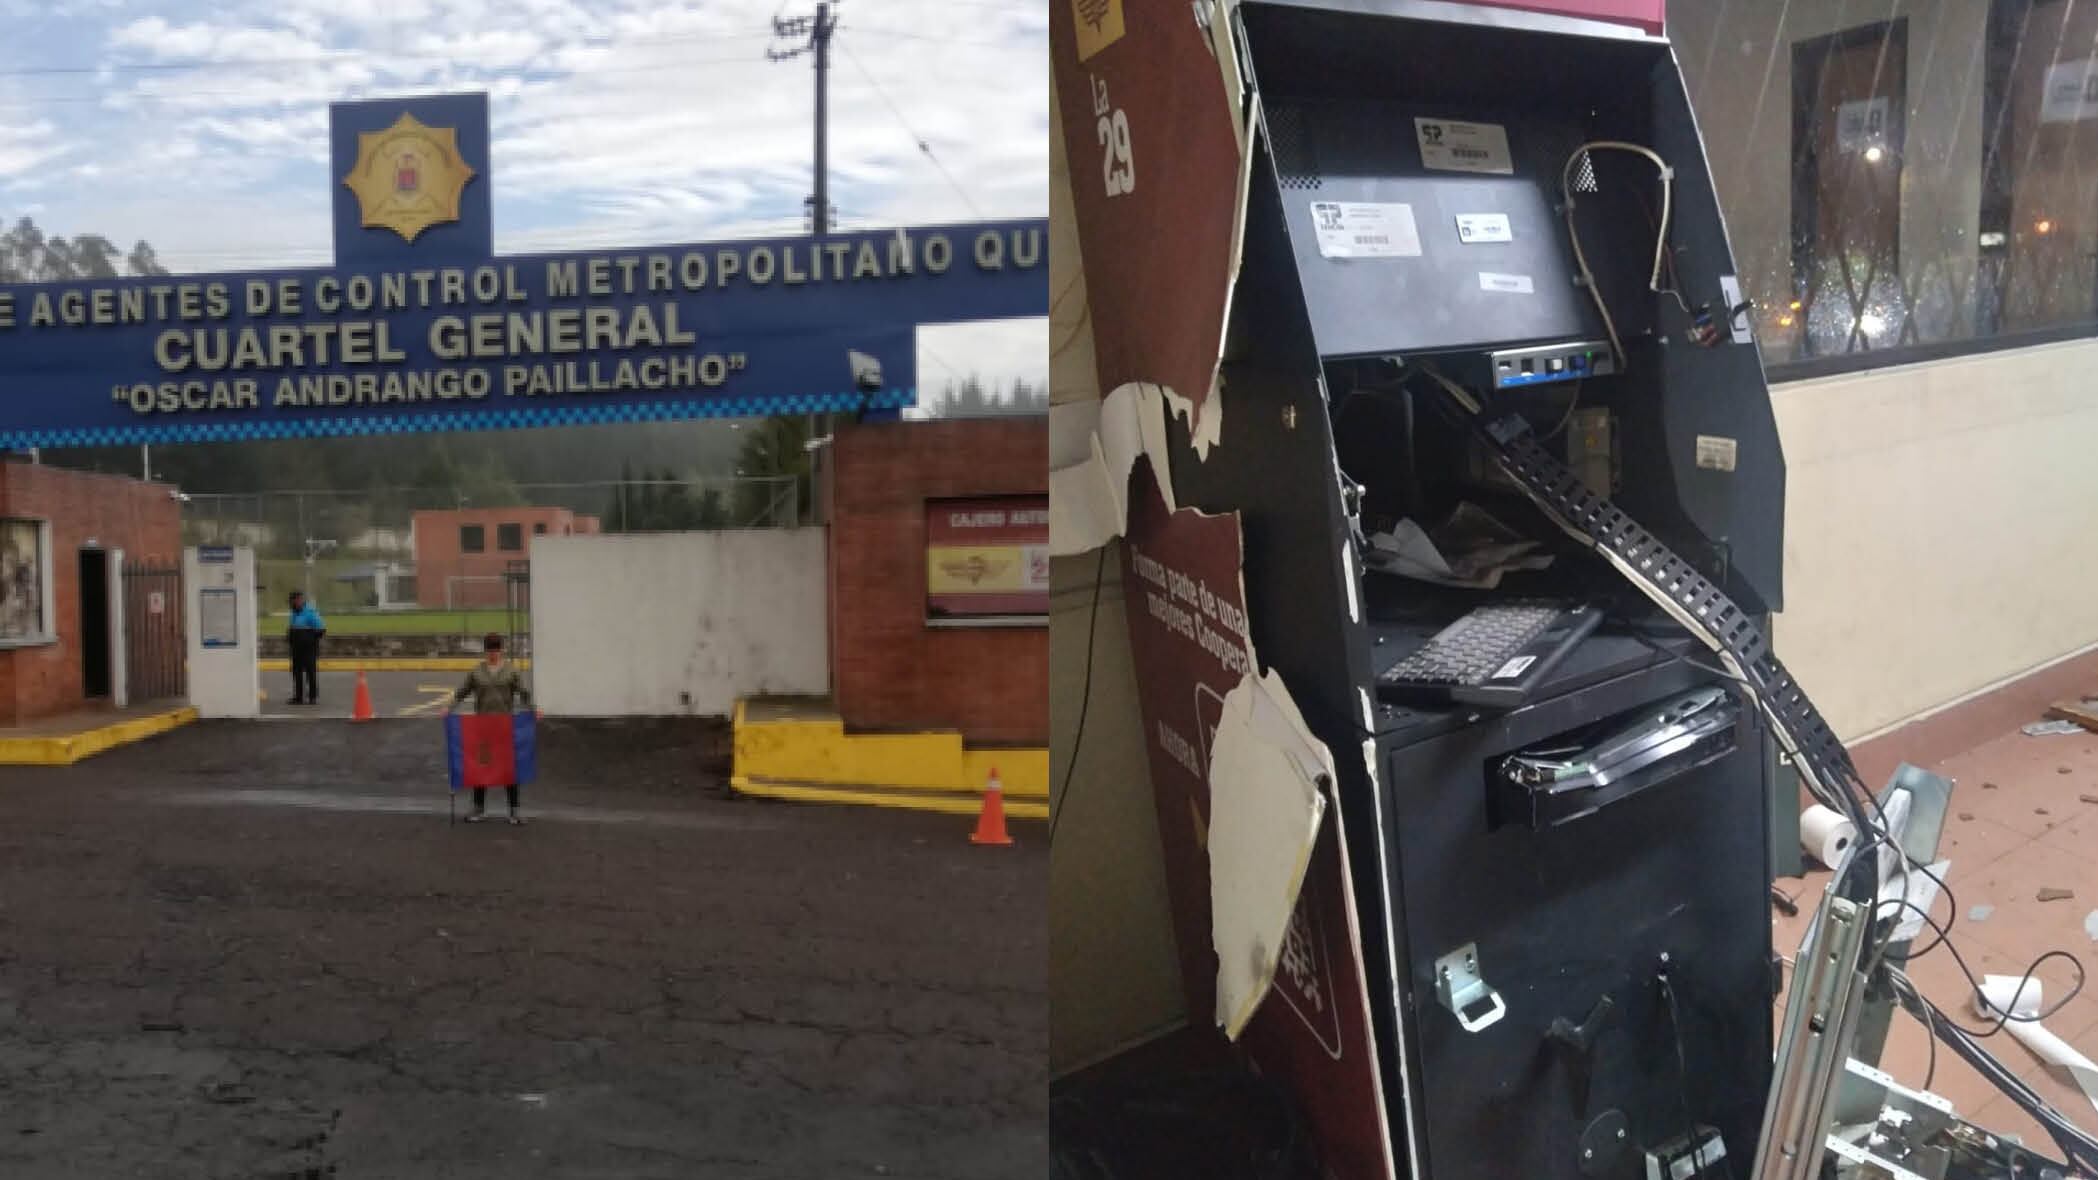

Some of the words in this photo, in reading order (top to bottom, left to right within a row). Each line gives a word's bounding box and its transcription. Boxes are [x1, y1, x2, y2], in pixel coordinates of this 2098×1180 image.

[1090, 73, 1110, 117] La
[1097, 108, 1136, 198] 29
[30, 281, 231, 327] AGENTES
[246, 279, 304, 316] DE
[315, 263, 528, 311] CONTROL
[546, 233, 952, 297] METROPOLITANO
[974, 229, 1040, 271] QU
[154, 319, 406, 372] CUARTEL
[429, 302, 696, 360] GENERAL
[112, 378, 260, 414] “OSCAR
[273, 367, 491, 407] ANDRANGO
[503, 353, 747, 395] PAILLACHO”
[1147, 592, 1195, 641] mejores
[1198, 579, 1218, 620] de
